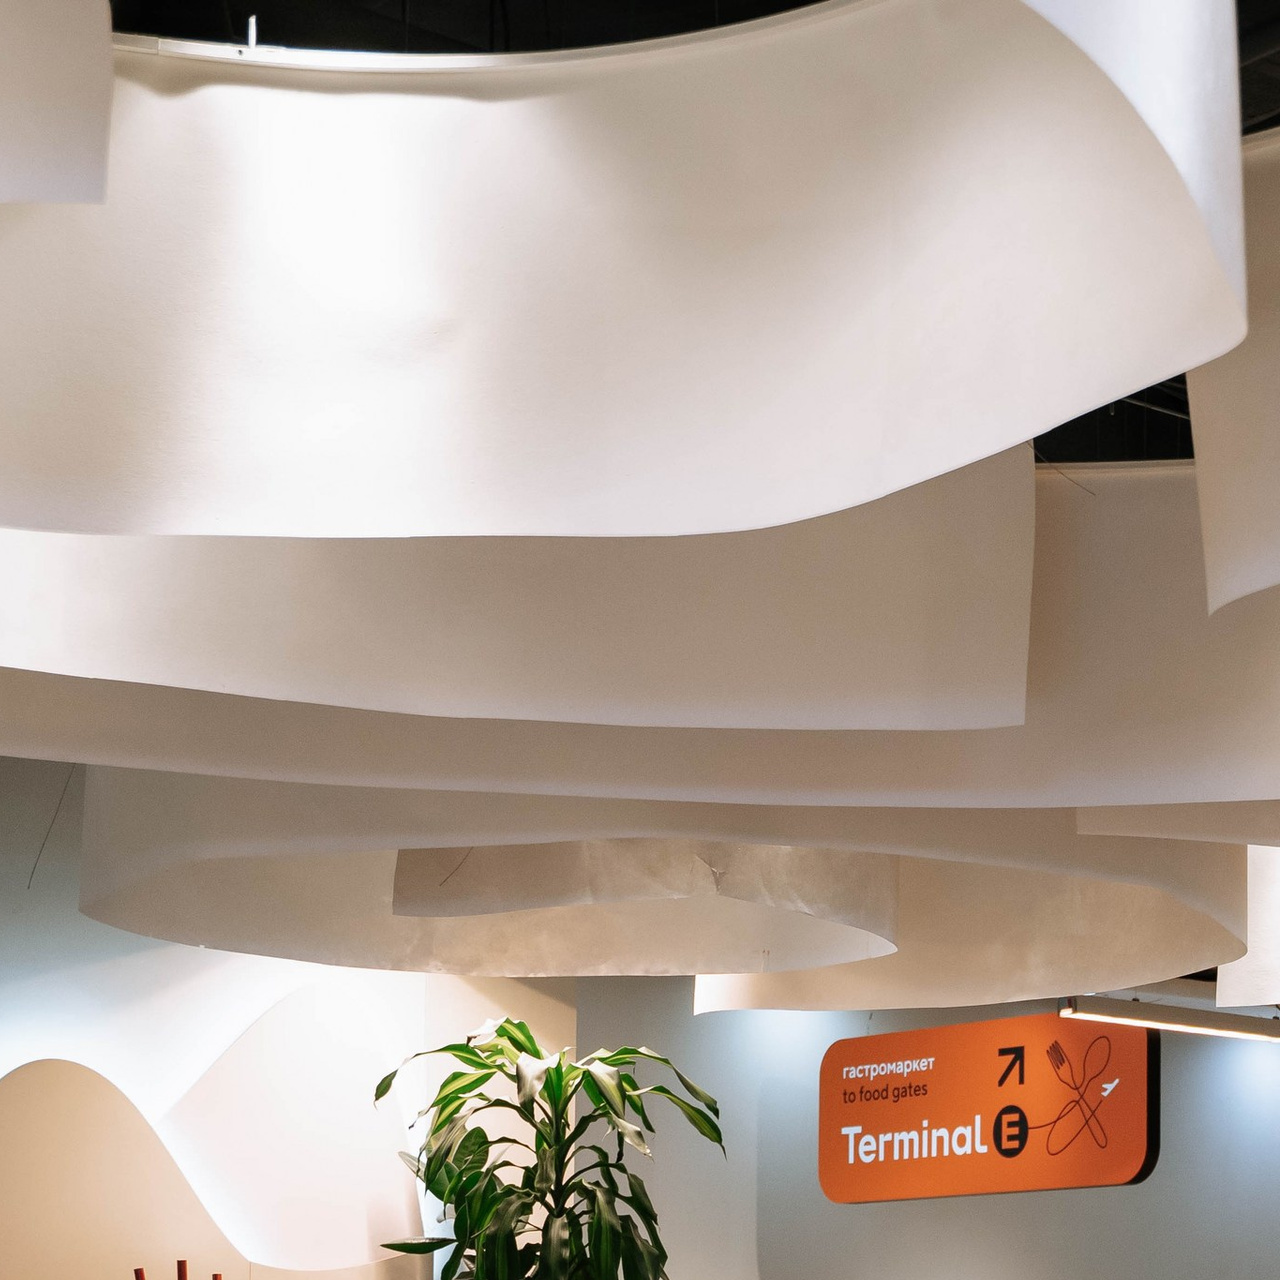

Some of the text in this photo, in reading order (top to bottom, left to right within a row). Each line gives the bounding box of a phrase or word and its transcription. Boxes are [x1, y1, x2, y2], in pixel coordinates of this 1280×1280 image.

[843, 1057, 935, 1081] гастромаркет
[843, 1082, 928, 1104] to food gates
[841, 1114, 988, 1164] Terminal
